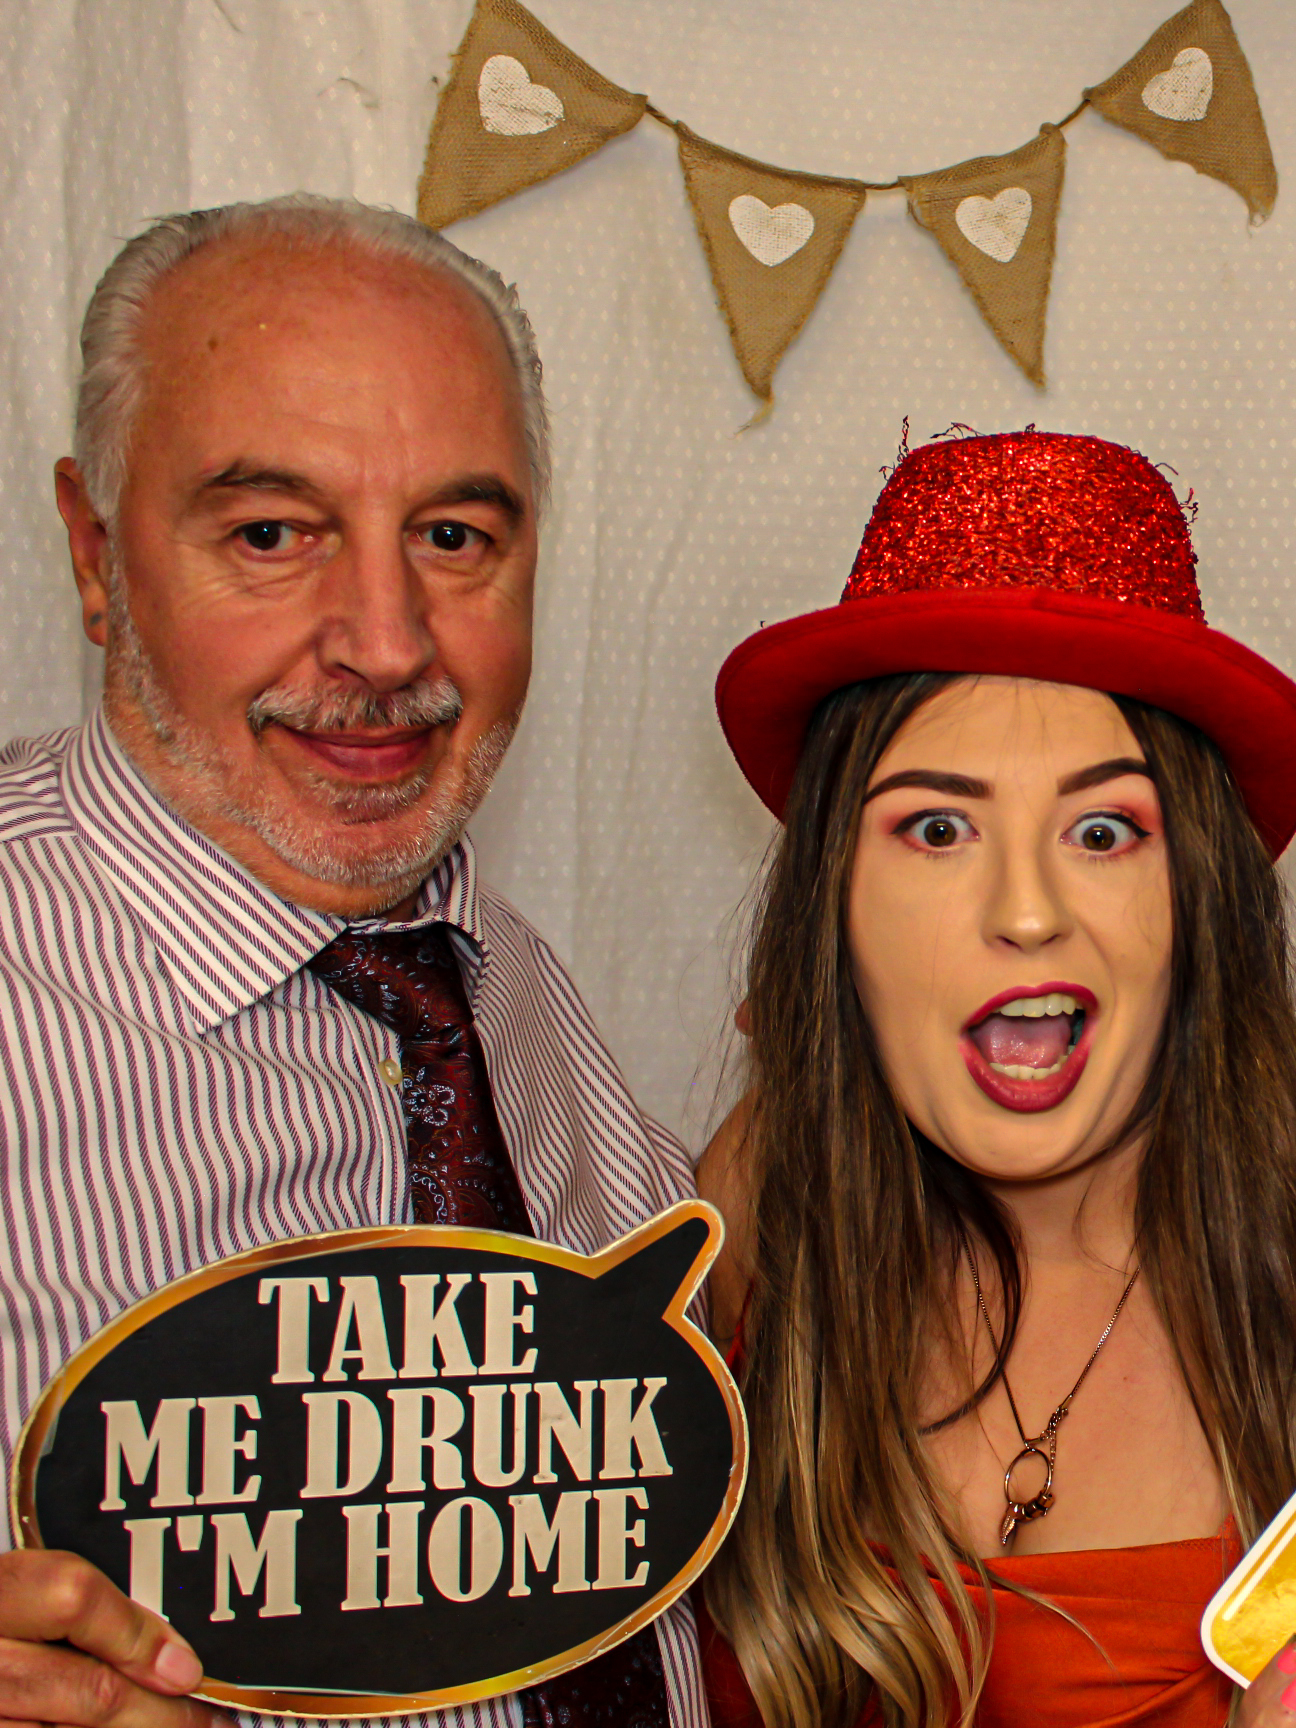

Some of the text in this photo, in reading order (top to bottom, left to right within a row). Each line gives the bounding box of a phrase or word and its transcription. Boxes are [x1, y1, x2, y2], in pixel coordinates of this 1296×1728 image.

[258, 1272, 540, 1385] TAKE
[100, 1376, 674, 1511] ME DRUNK
[124, 1486, 651, 1622] I'M HOME
